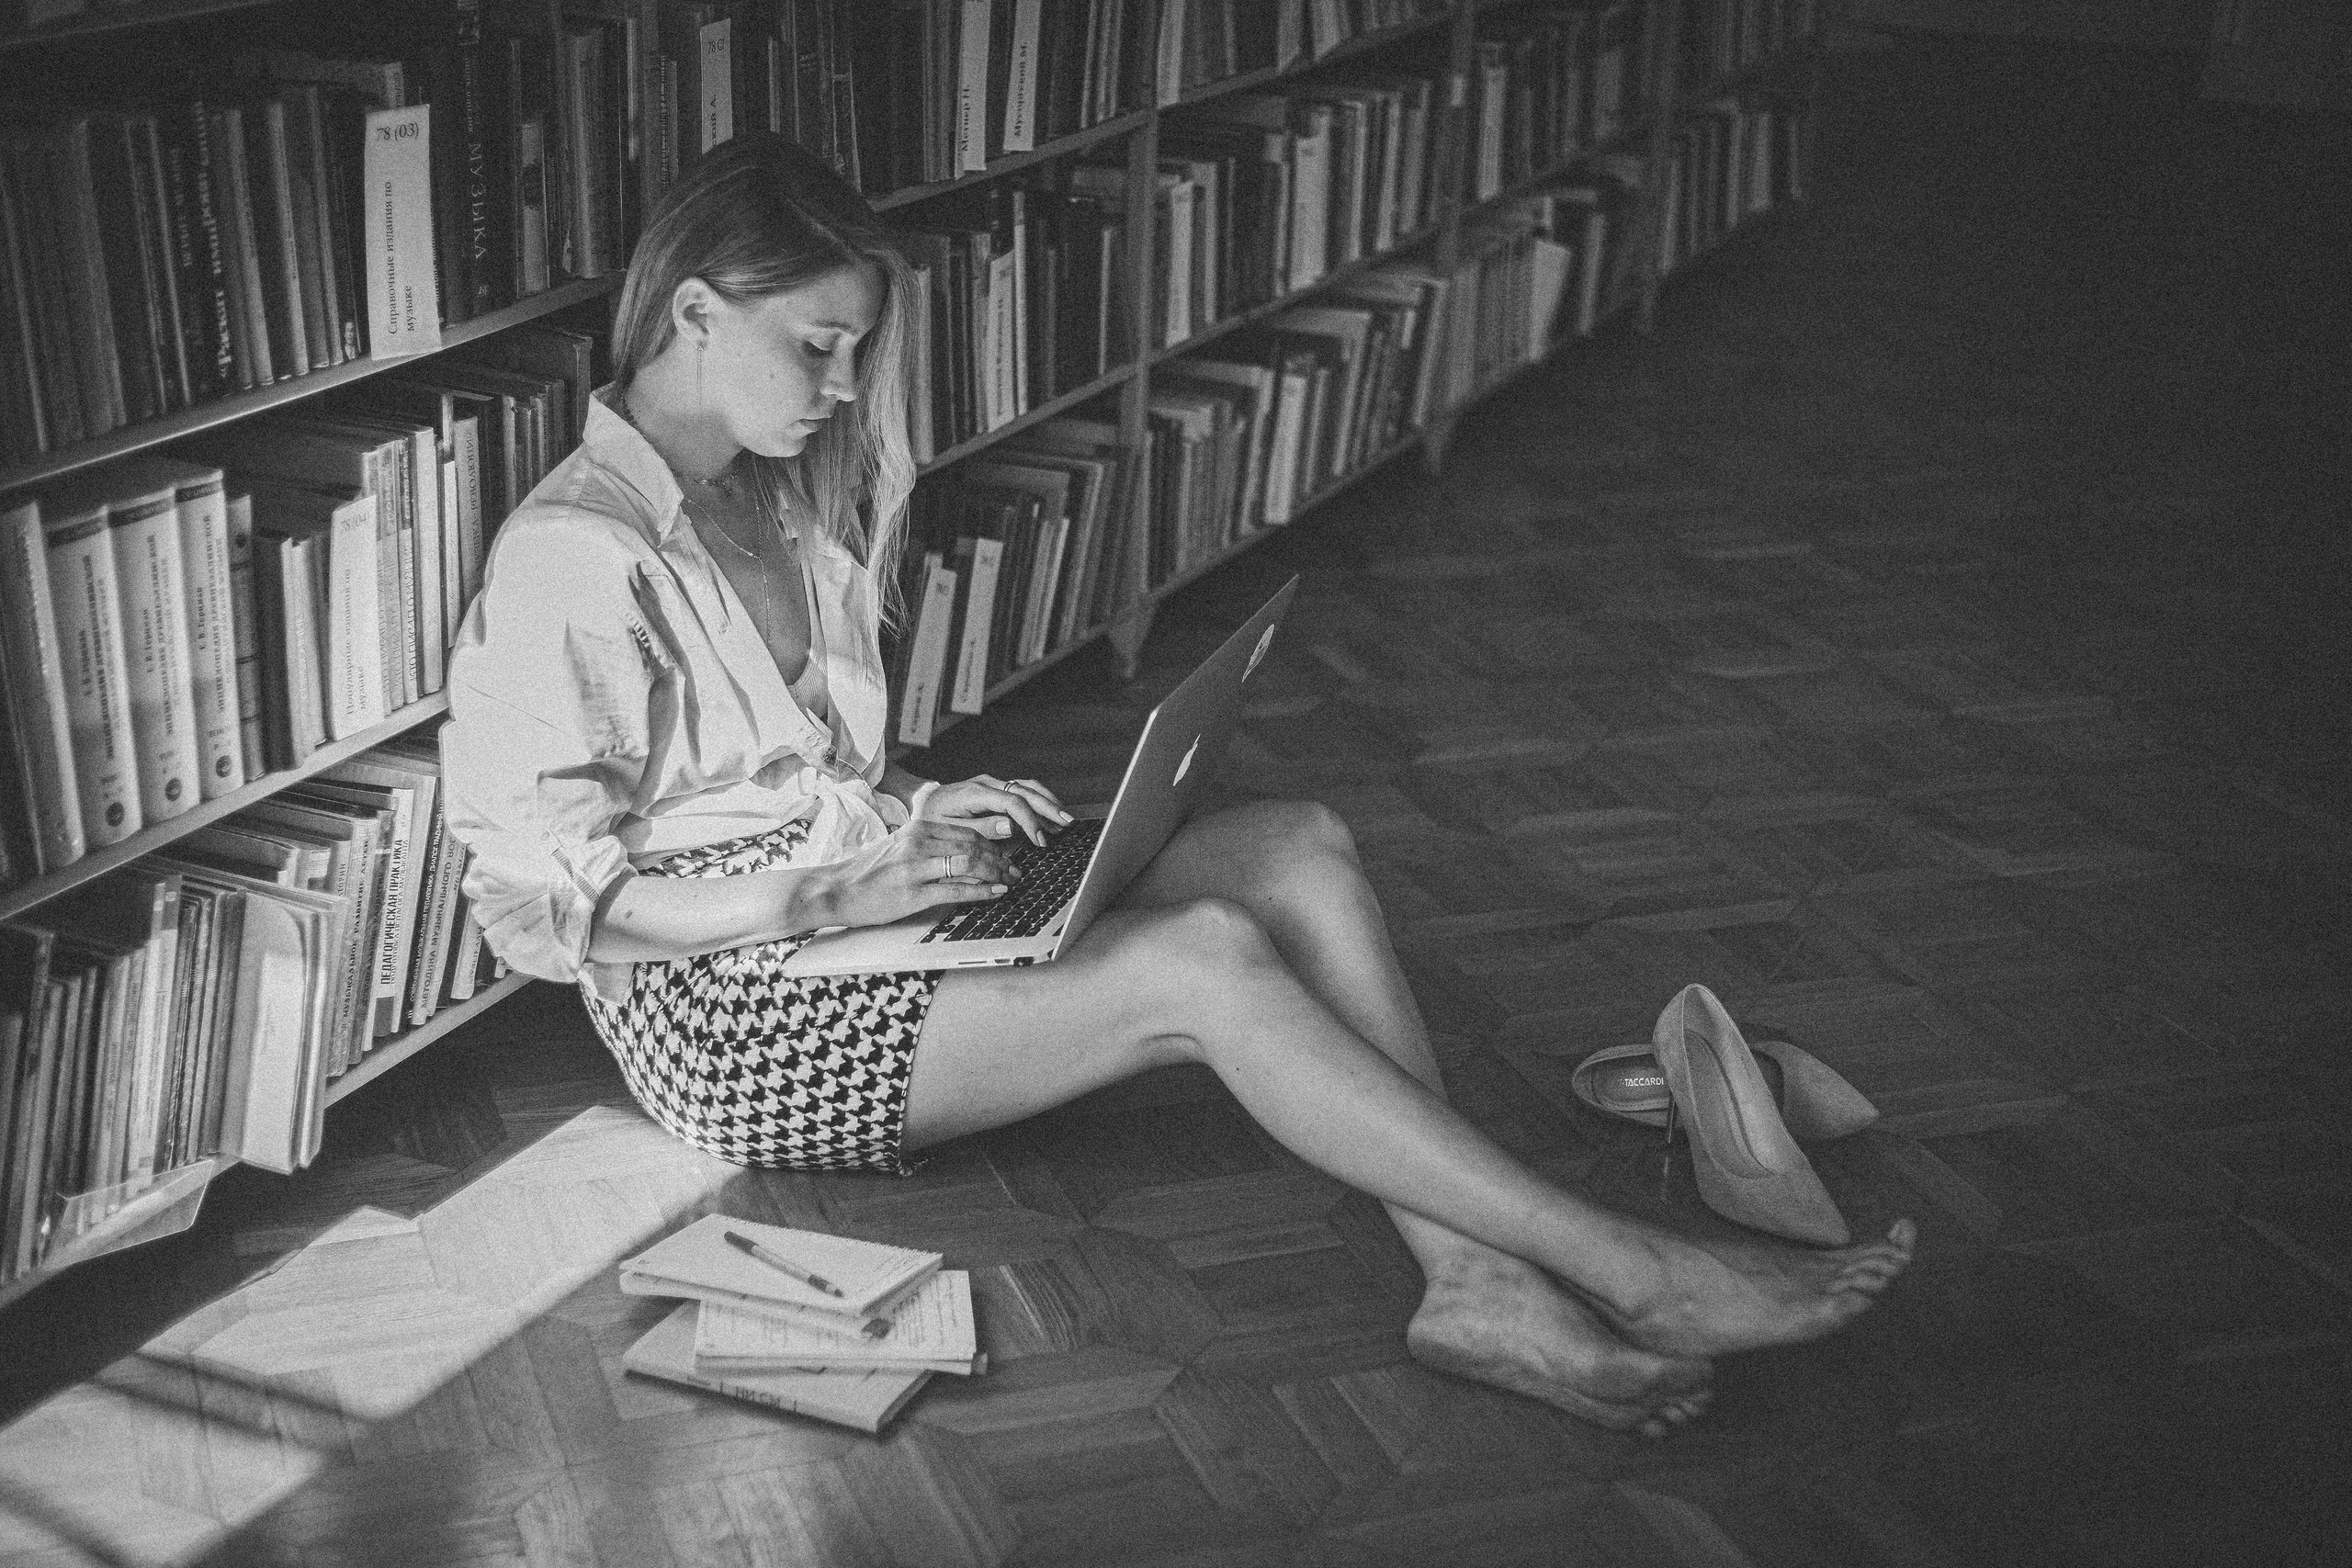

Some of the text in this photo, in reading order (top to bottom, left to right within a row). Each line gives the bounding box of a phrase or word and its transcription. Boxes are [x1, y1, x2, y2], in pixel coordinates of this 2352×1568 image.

[377, 122, 419, 141] 78 (03)
[469, 142, 488, 260] МУЗЫКА
[382, 181, 399, 335] Справочные издания по
[402, 285, 415, 333] музыке
[343, 586, 352, 636] издания
[344, 639, 356, 716] Популярные
[356, 665, 368, 711] музыке
[388, 839, 403, 892] ПРАКТИКА
[429, 846, 439, 872] ДИАЛОГ
[342, 938, 357, 1018] МУЗЫКАЛЬНОЕ
[352, 879, 365, 934] РАЗВИТИЕ
[379, 894, 398, 985] ПЕДАГОГИЧЕСКАЯ
[415, 913, 428, 957] МУЗЫКАЛЬНАЯ
[420, 950, 437, 1009] МЕТОДИКА
[429, 861, 452, 946] МУЗЫКАЛЬНОГО
[409, 957, 423, 1002] СОВРЕМЕННАЯ
